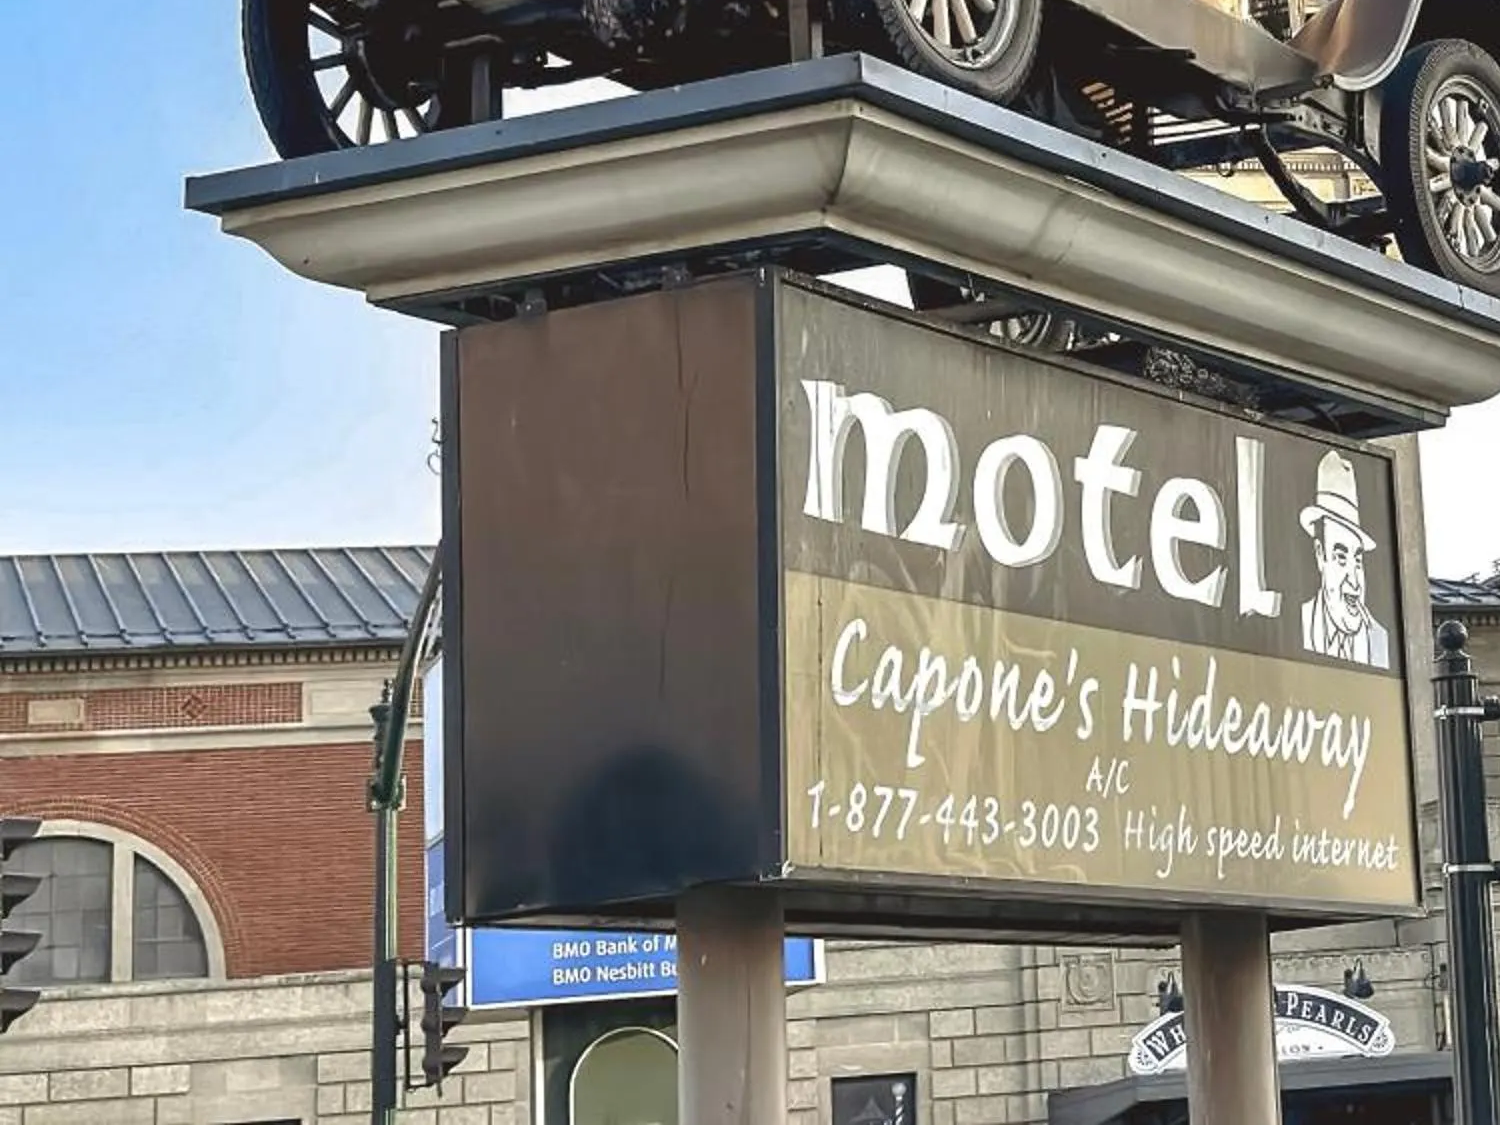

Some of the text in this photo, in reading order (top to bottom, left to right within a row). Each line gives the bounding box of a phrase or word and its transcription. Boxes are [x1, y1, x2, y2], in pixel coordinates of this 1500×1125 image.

[801, 379, 1281, 618] motel
[831, 618, 1371, 820] Capone's Hideaway
[1085, 755, 1129, 798] A/C
[807, 780, 1099, 852] 1-877-443-3003
[1124, 804, 1399, 879] High speed internet
[552, 941, 591, 960] BMO
[597, 936, 637, 956] Bank
[643, 934, 661, 952] of
[552, 965, 591, 986] BMO
[597, 961, 655, 982] Nesbitt
[1286, 992, 1372, 1046] PEARLS
